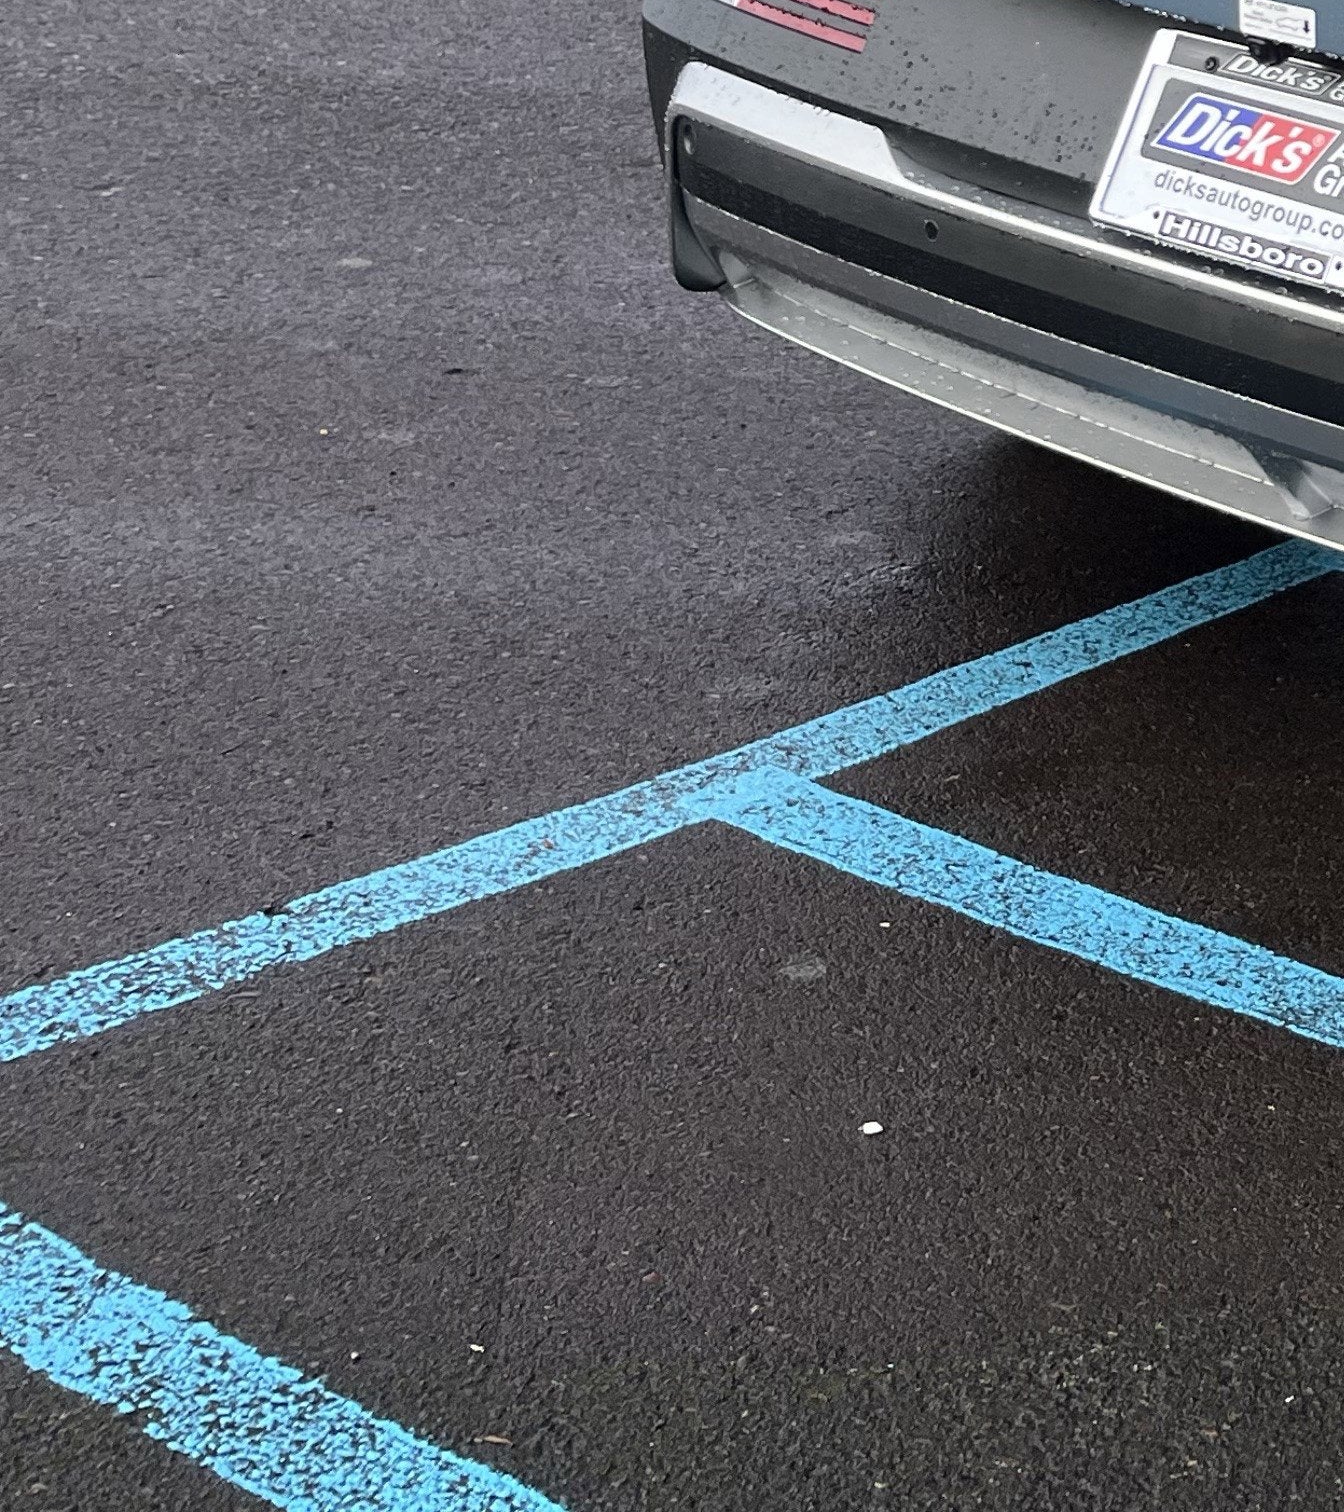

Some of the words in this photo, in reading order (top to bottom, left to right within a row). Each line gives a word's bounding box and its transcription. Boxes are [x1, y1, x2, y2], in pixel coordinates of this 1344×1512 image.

[1227, 55, 1325, 92] Dick's
[1166, 102, 1312, 174] Dick's
[1160, 213, 1325, 277] Hillsboro
